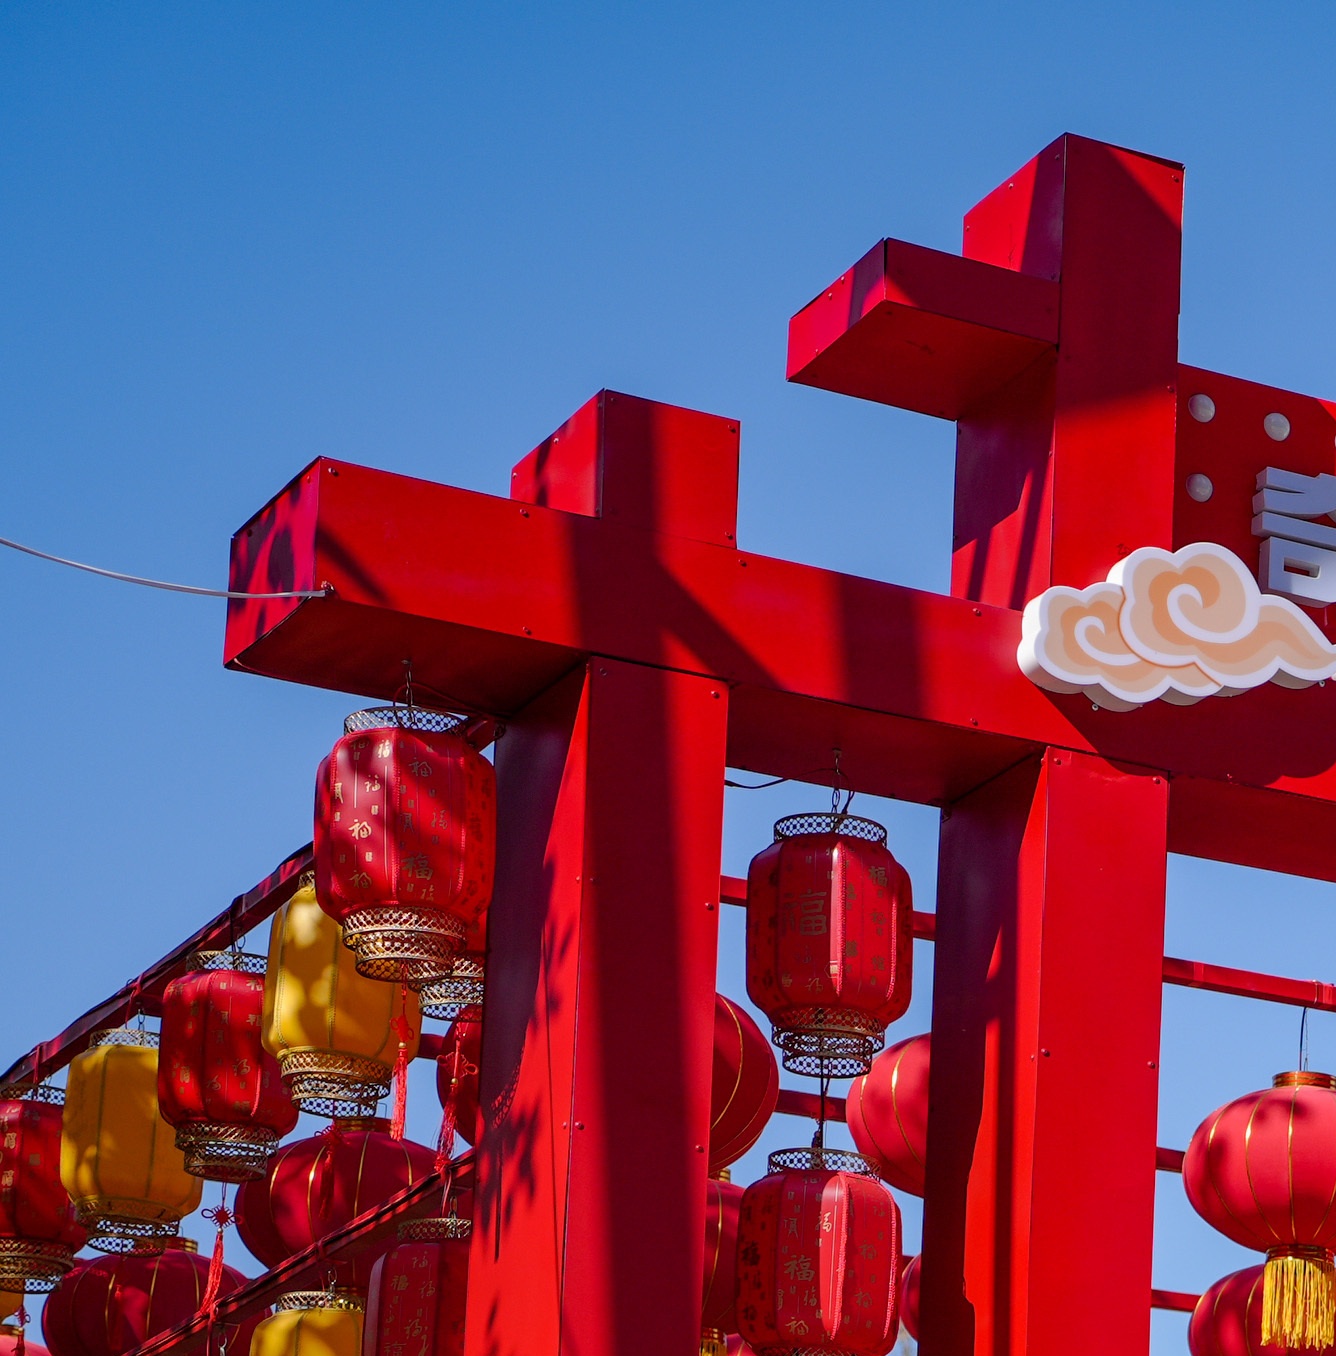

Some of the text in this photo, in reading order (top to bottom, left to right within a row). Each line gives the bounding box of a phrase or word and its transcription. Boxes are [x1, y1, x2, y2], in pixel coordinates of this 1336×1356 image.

[402, 852, 434, 881] 福
[781, 888, 827, 936] 福
[784, 1255, 815, 1281] 福
